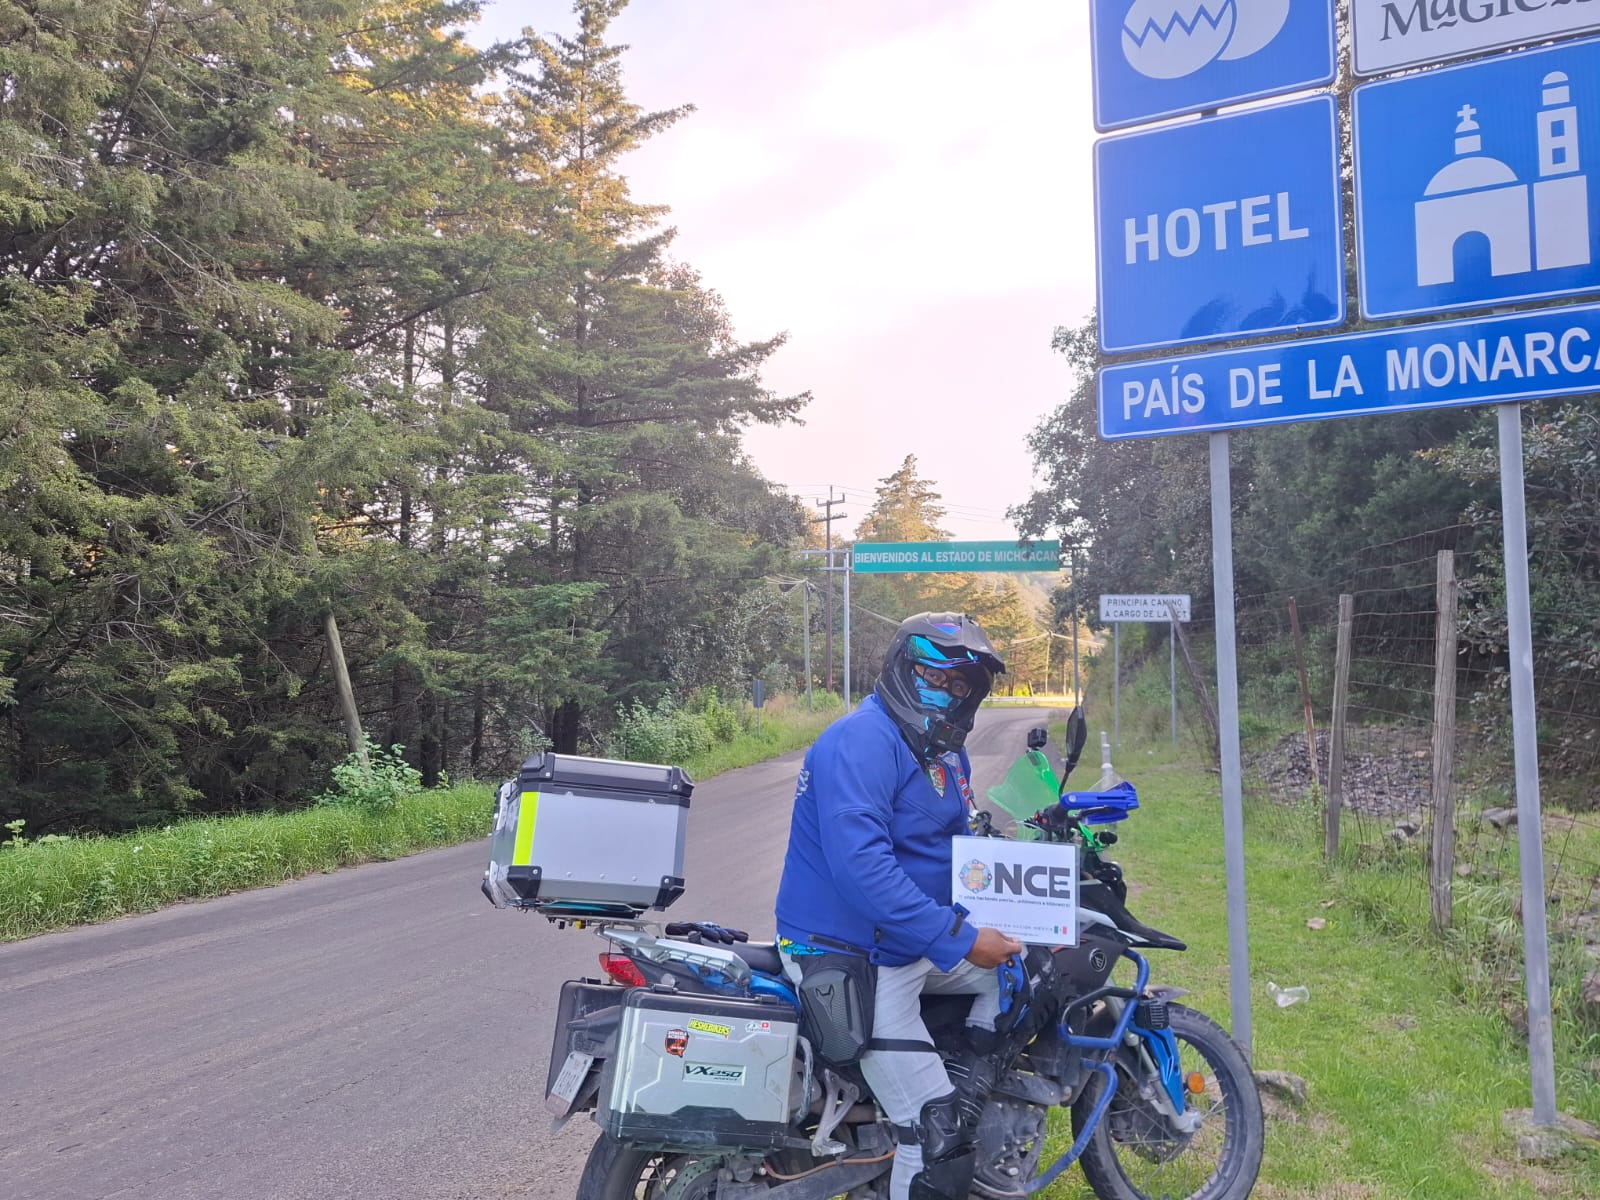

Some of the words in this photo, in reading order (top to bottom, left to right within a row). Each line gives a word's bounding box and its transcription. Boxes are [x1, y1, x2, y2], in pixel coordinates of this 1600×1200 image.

[1124, 191, 1309, 265] HOTEL
[1122, 365, 1205, 420] PAÍS
[1229, 364, 1283, 409] DE
[1308, 355, 1363, 400] LA
[1385, 327, 1600, 392] MONARC
[855, 551, 919, 563] BIENVENIDOS
[921, 551, 934, 562] AL
[936, 551, 975, 562] ESTADO
[978, 551, 992, 562] DE
[1107, 599, 1148, 607] PRINCIPIA
[1151, 599, 1183, 607] CAMNO
[685, 1065, 742, 1077] VX250
